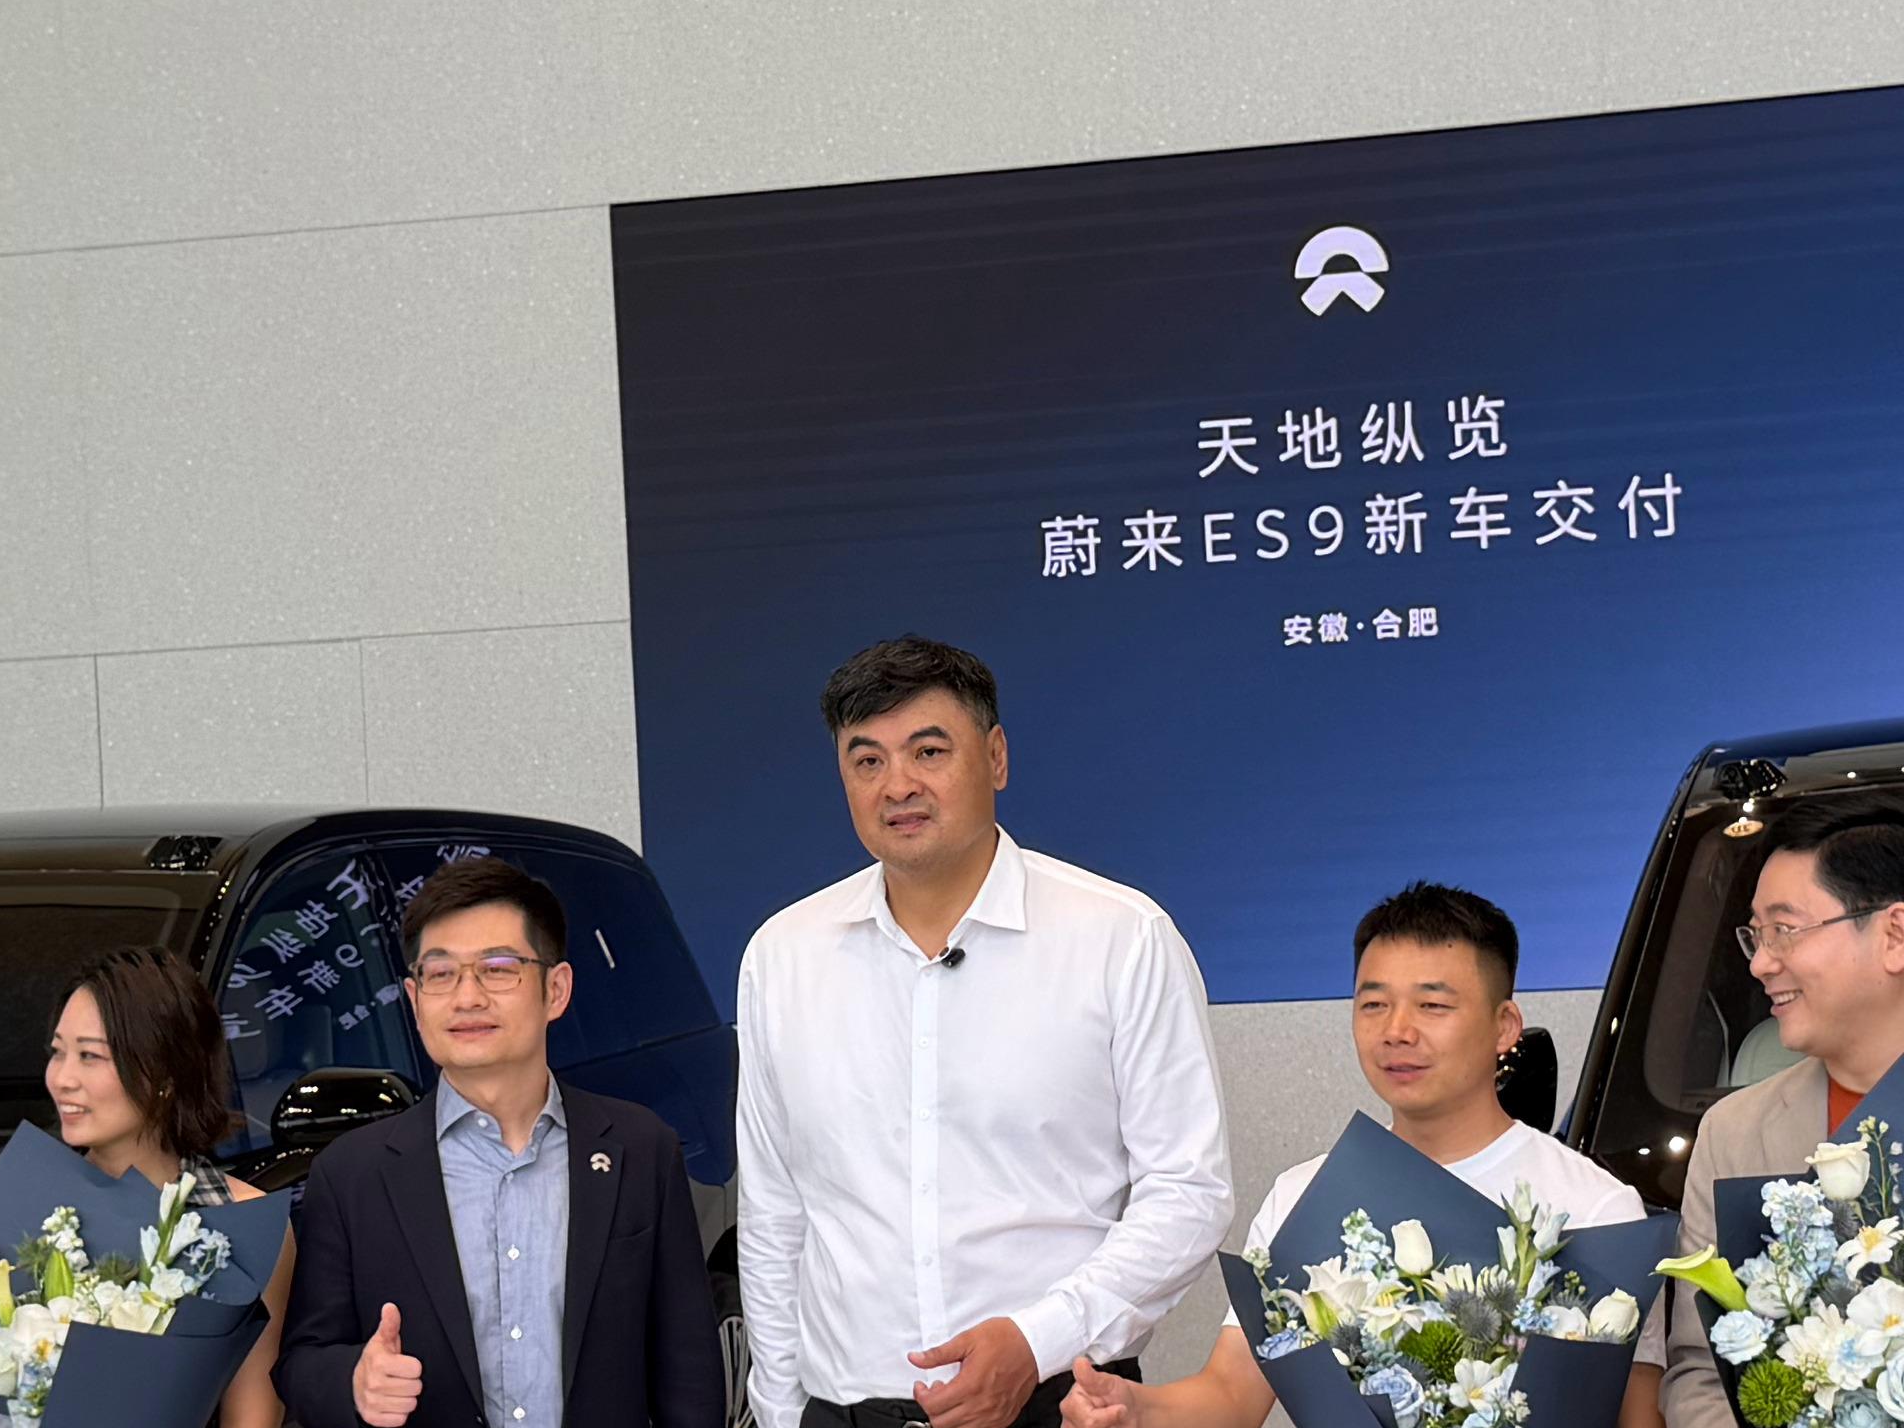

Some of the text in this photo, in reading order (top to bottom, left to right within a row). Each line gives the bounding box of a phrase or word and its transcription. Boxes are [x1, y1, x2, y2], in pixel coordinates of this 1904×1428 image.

[1197, 394, 1508, 478] 天地纵览
[1040, 472, 1682, 578] 蔚来ES9新车交付
[1283, 607, 1439, 646] 安徽·合肥
